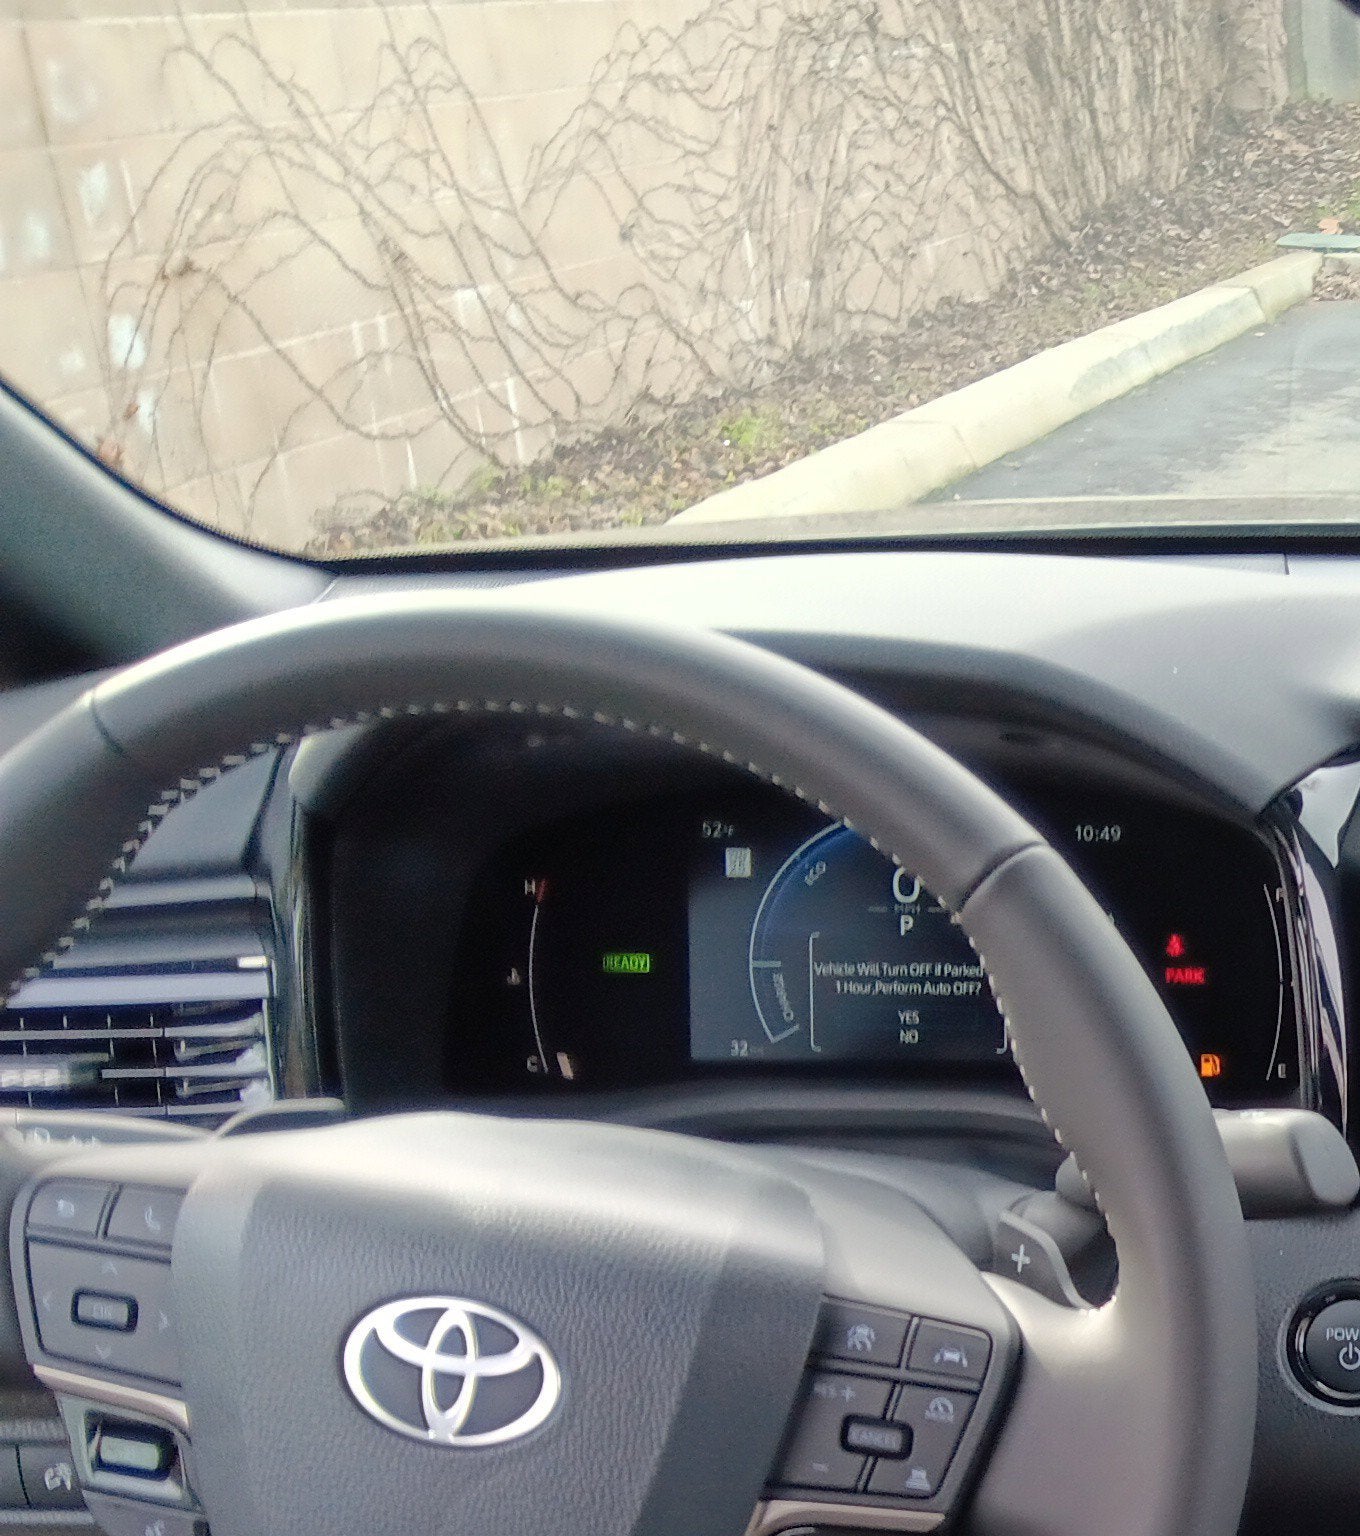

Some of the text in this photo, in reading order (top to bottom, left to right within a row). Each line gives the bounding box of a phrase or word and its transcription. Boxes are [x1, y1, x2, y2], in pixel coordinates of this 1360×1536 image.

[1074, 823, 1122, 842] 10:49
[900, 914, 914, 937] P
[813, 961, 855, 977] Vehicle
[923, 981, 952, 995] Auto
[898, 1009, 920, 1026] YES
[899, 1029, 919, 1044] NO
